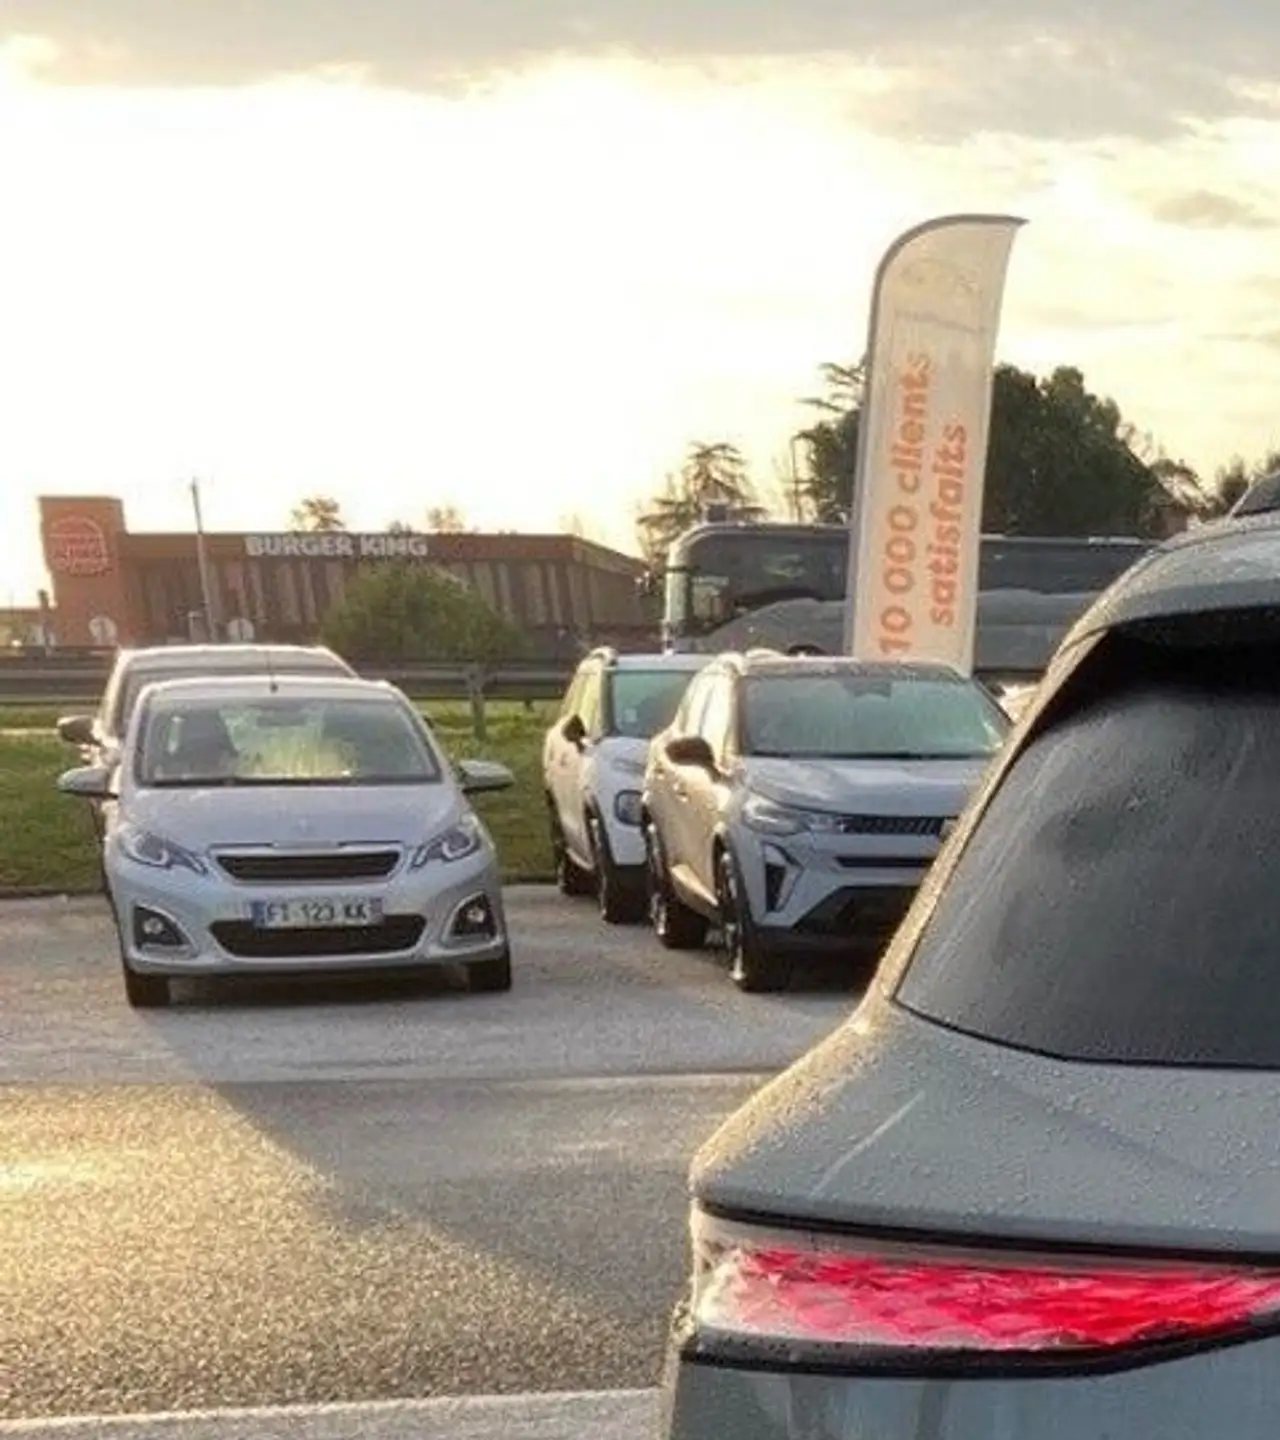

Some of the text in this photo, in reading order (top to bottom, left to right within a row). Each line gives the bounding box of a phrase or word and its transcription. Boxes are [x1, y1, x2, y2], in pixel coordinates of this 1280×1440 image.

[244, 535, 428, 557] BURGER KING
[879, 352, 931, 654] 10 000 clients
[926, 424, 968, 627] satisfaits
